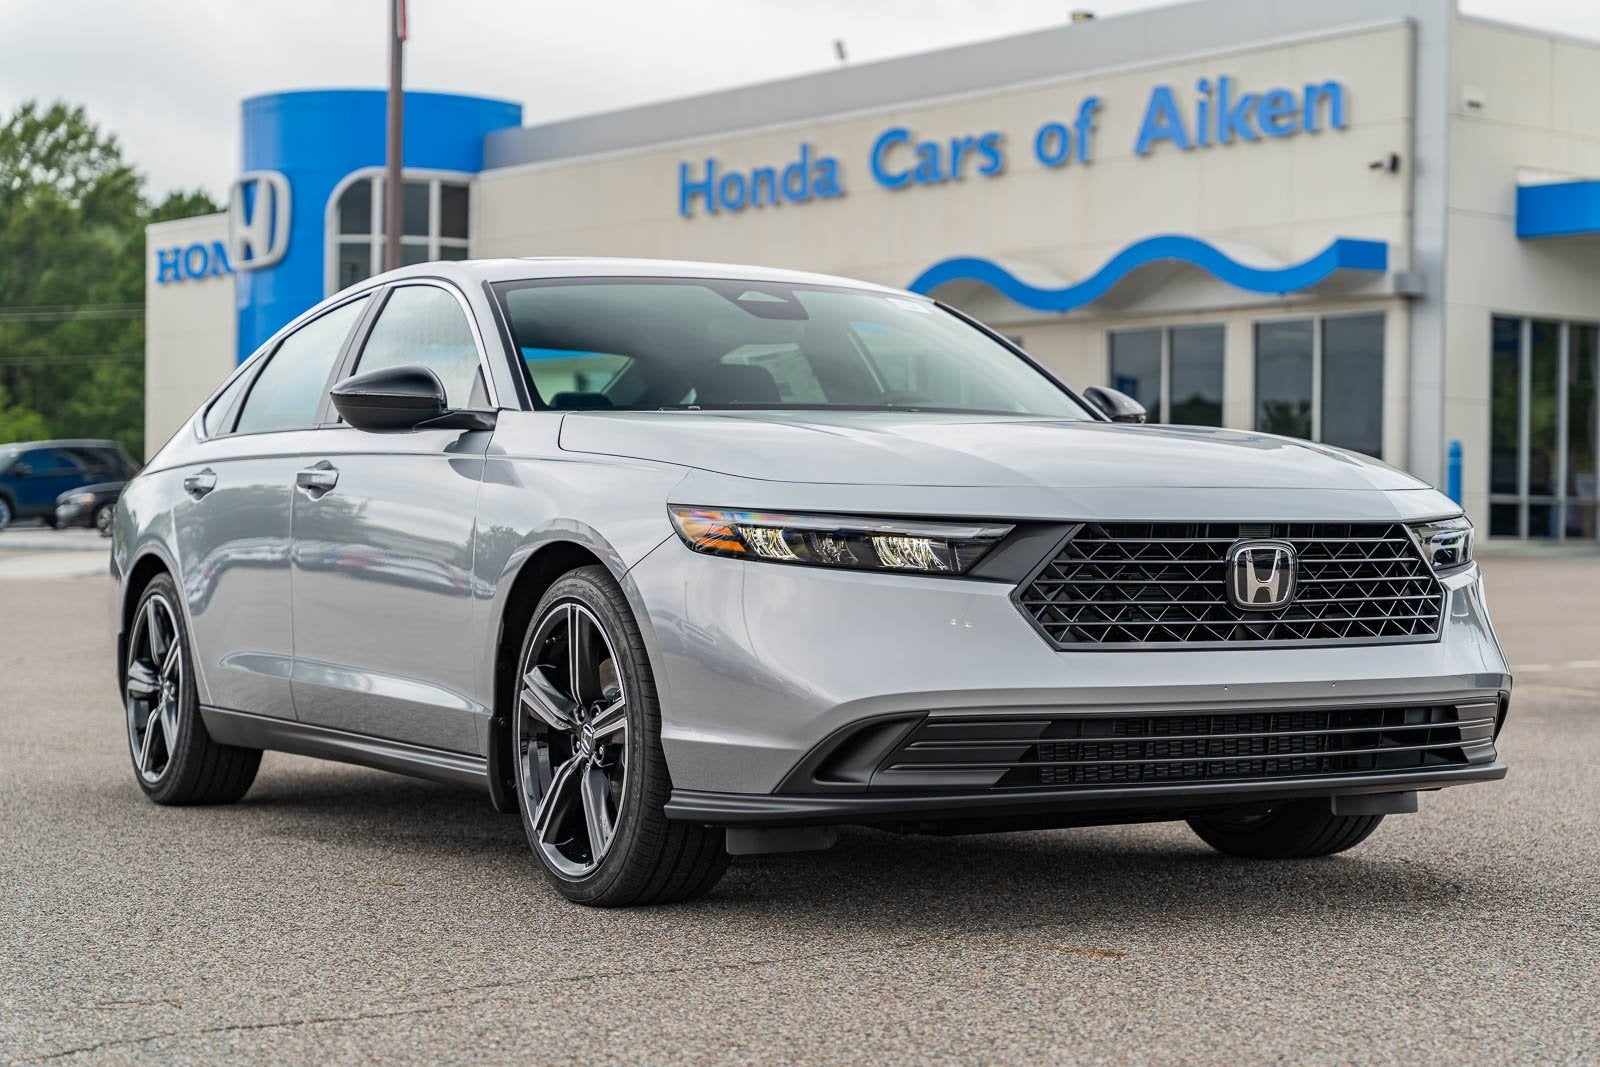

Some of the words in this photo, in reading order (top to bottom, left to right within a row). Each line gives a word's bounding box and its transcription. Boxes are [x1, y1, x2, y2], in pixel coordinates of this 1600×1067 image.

[678, 141, 841, 216] Honda
[869, 126, 1004, 190] Cars
[1033, 95, 1101, 167] of
[1133, 74, 1344, 155] Aiken
